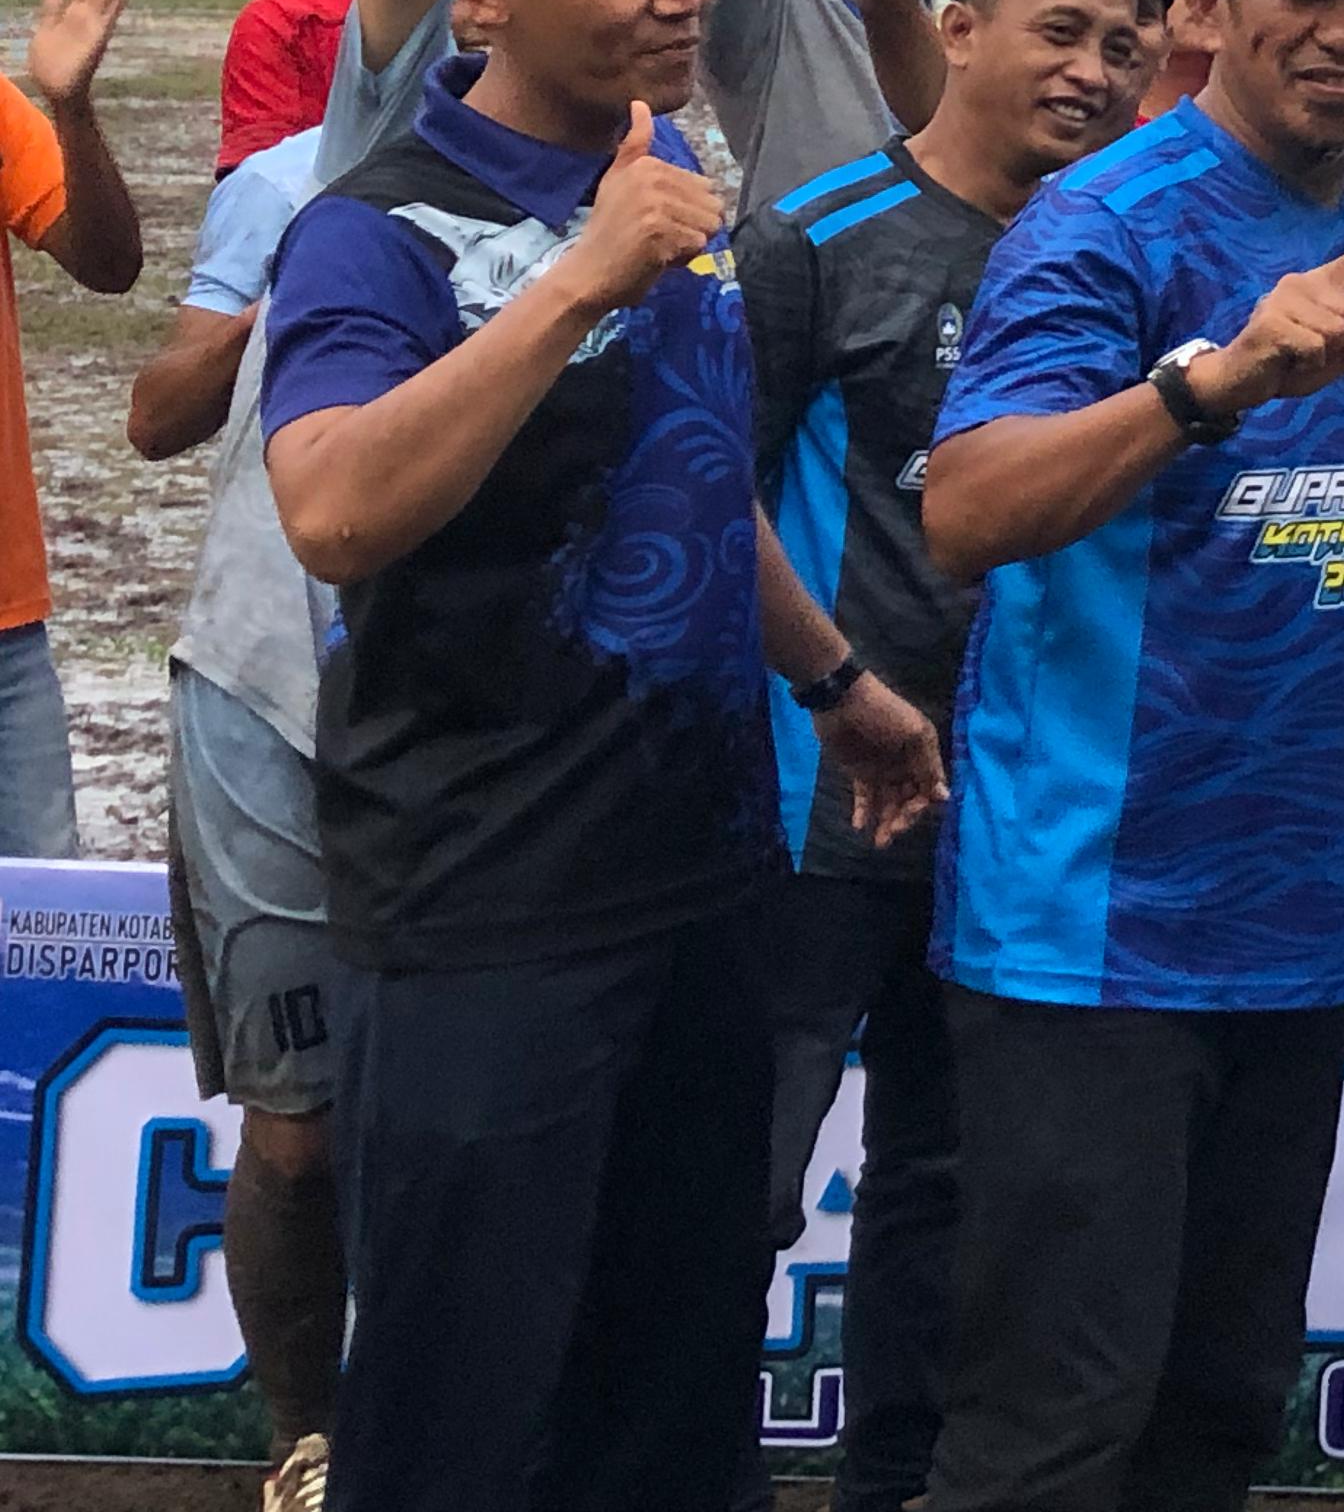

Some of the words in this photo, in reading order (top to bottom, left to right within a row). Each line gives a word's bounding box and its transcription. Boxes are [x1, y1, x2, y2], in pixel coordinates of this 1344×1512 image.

[935, 347, 962, 361] PSS
[9, 910, 112, 938] KABUPATEN
[117, 914, 174, 941] KOTAB
[6, 943, 178, 982] DISPARPOR
[269, 984, 329, 1053] 10
